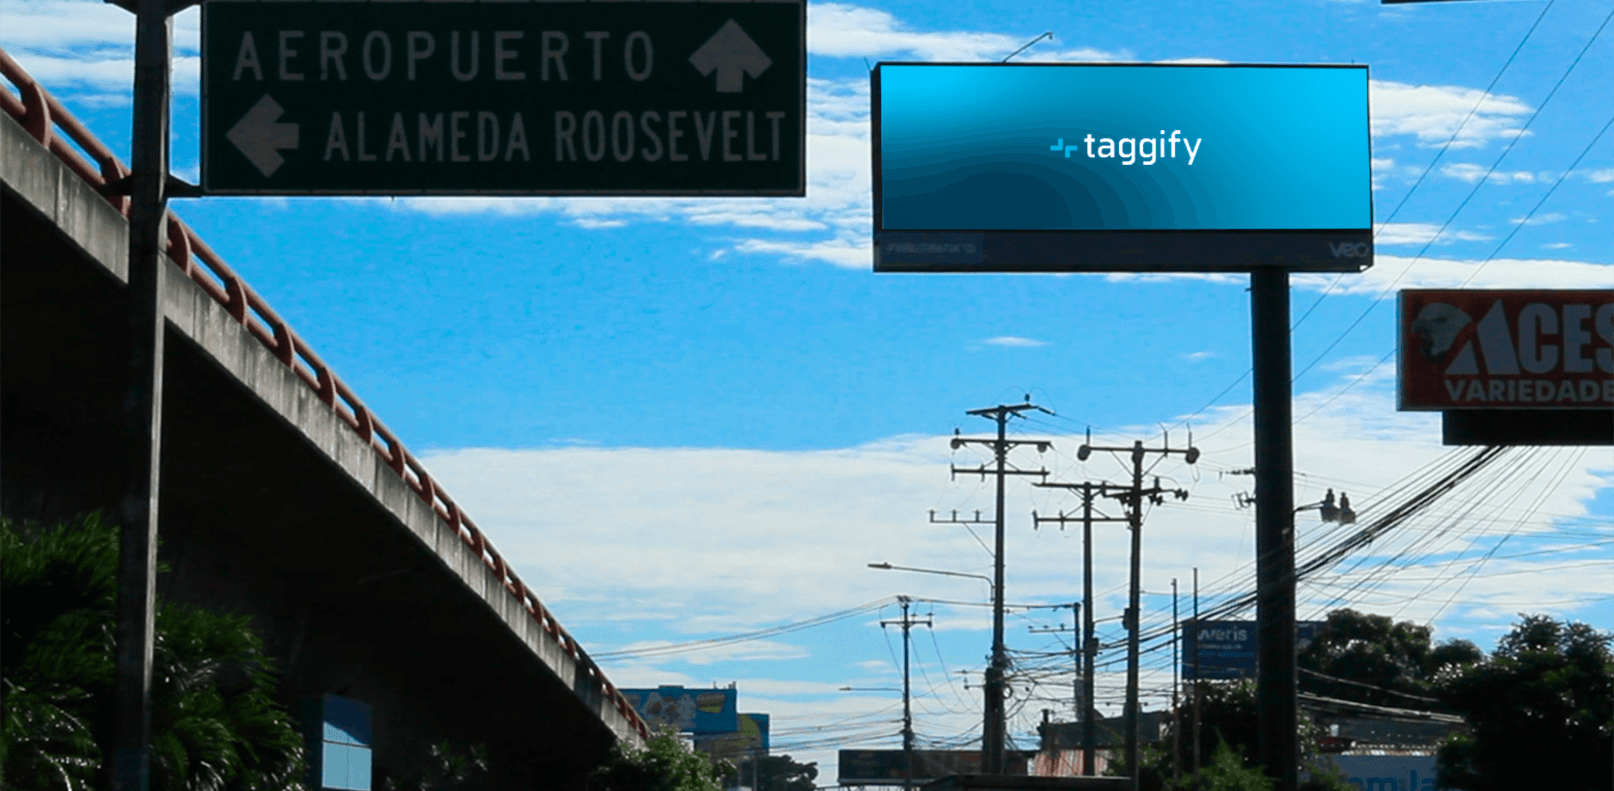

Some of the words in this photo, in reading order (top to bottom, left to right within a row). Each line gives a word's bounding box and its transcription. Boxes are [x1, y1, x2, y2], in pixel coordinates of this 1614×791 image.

[232, 30, 654, 82] AEROPUERTO
[323, 110, 531, 163] ALAMEDA
[554, 110, 787, 163] ROOSEVELT
[1083, 129, 1203, 166] taggify
